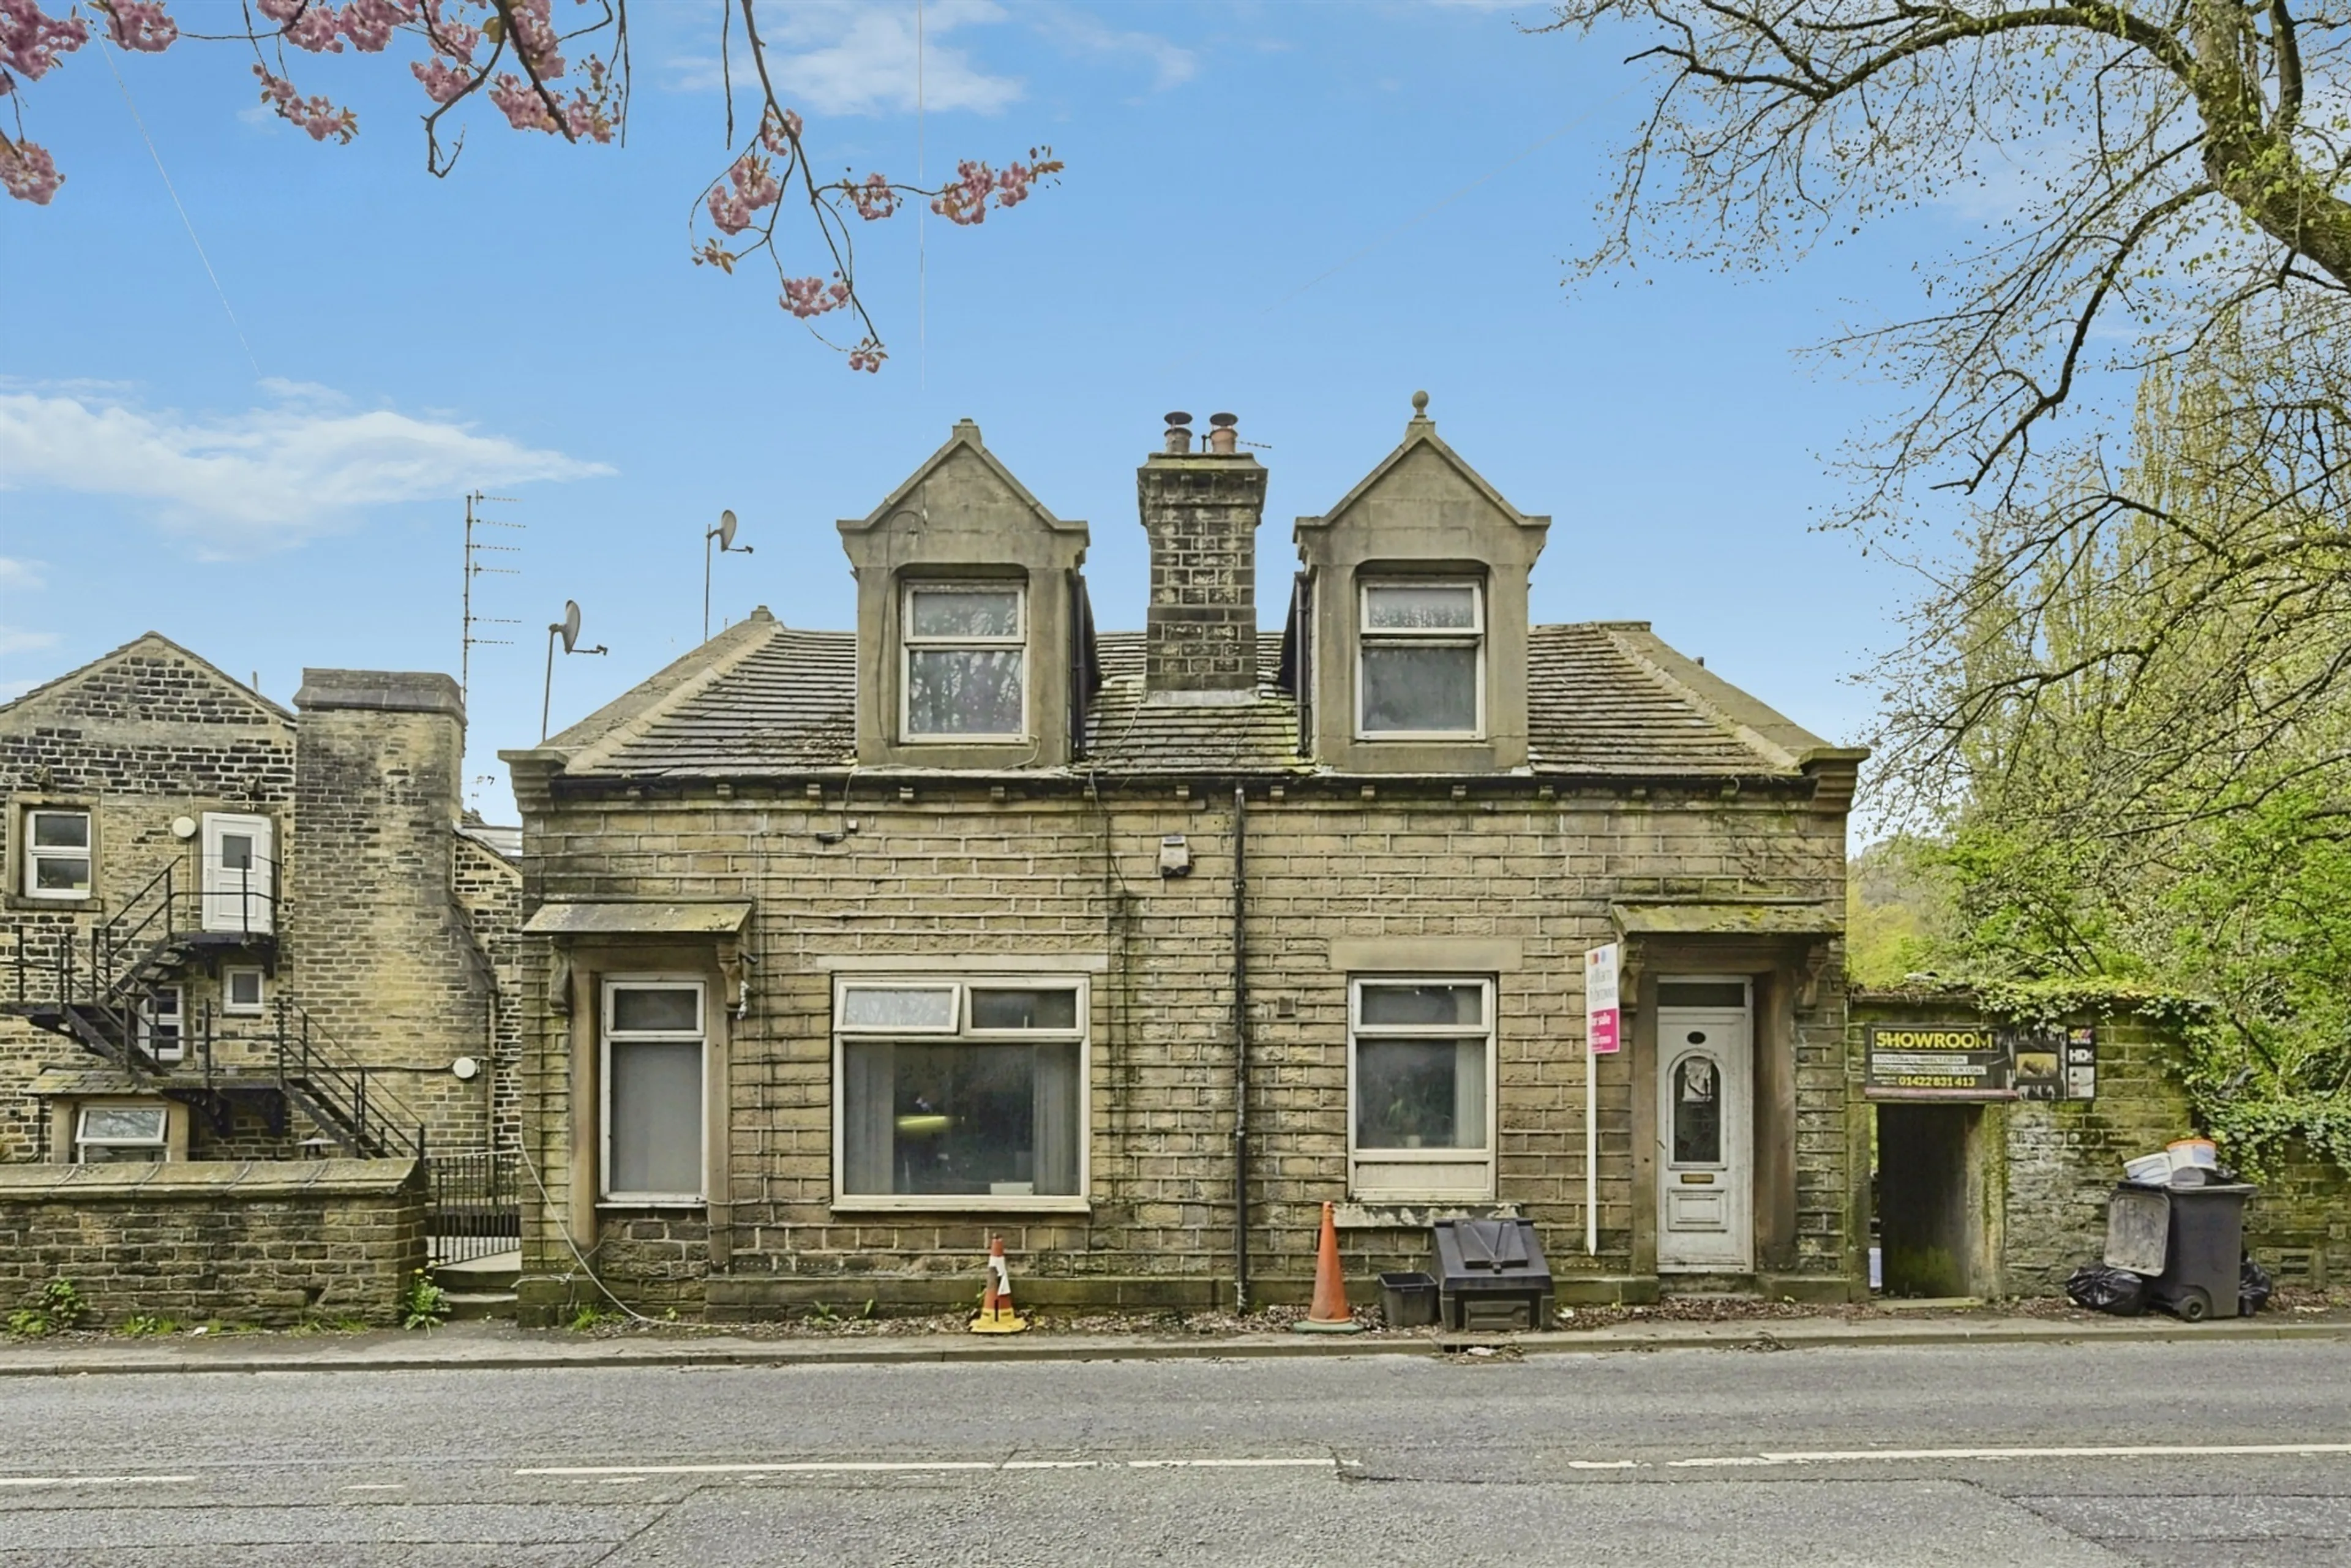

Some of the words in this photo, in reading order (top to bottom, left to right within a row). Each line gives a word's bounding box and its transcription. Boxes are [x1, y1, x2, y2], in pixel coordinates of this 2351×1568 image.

[1598, 1012, 1611, 1026] sale
[1875, 1032, 1992, 1048] SHOWROOM
[1898, 1076, 1932, 1086] 01422
[1933, 1076, 1953, 1087] 831
[1954, 1076, 1976, 1087] 413
